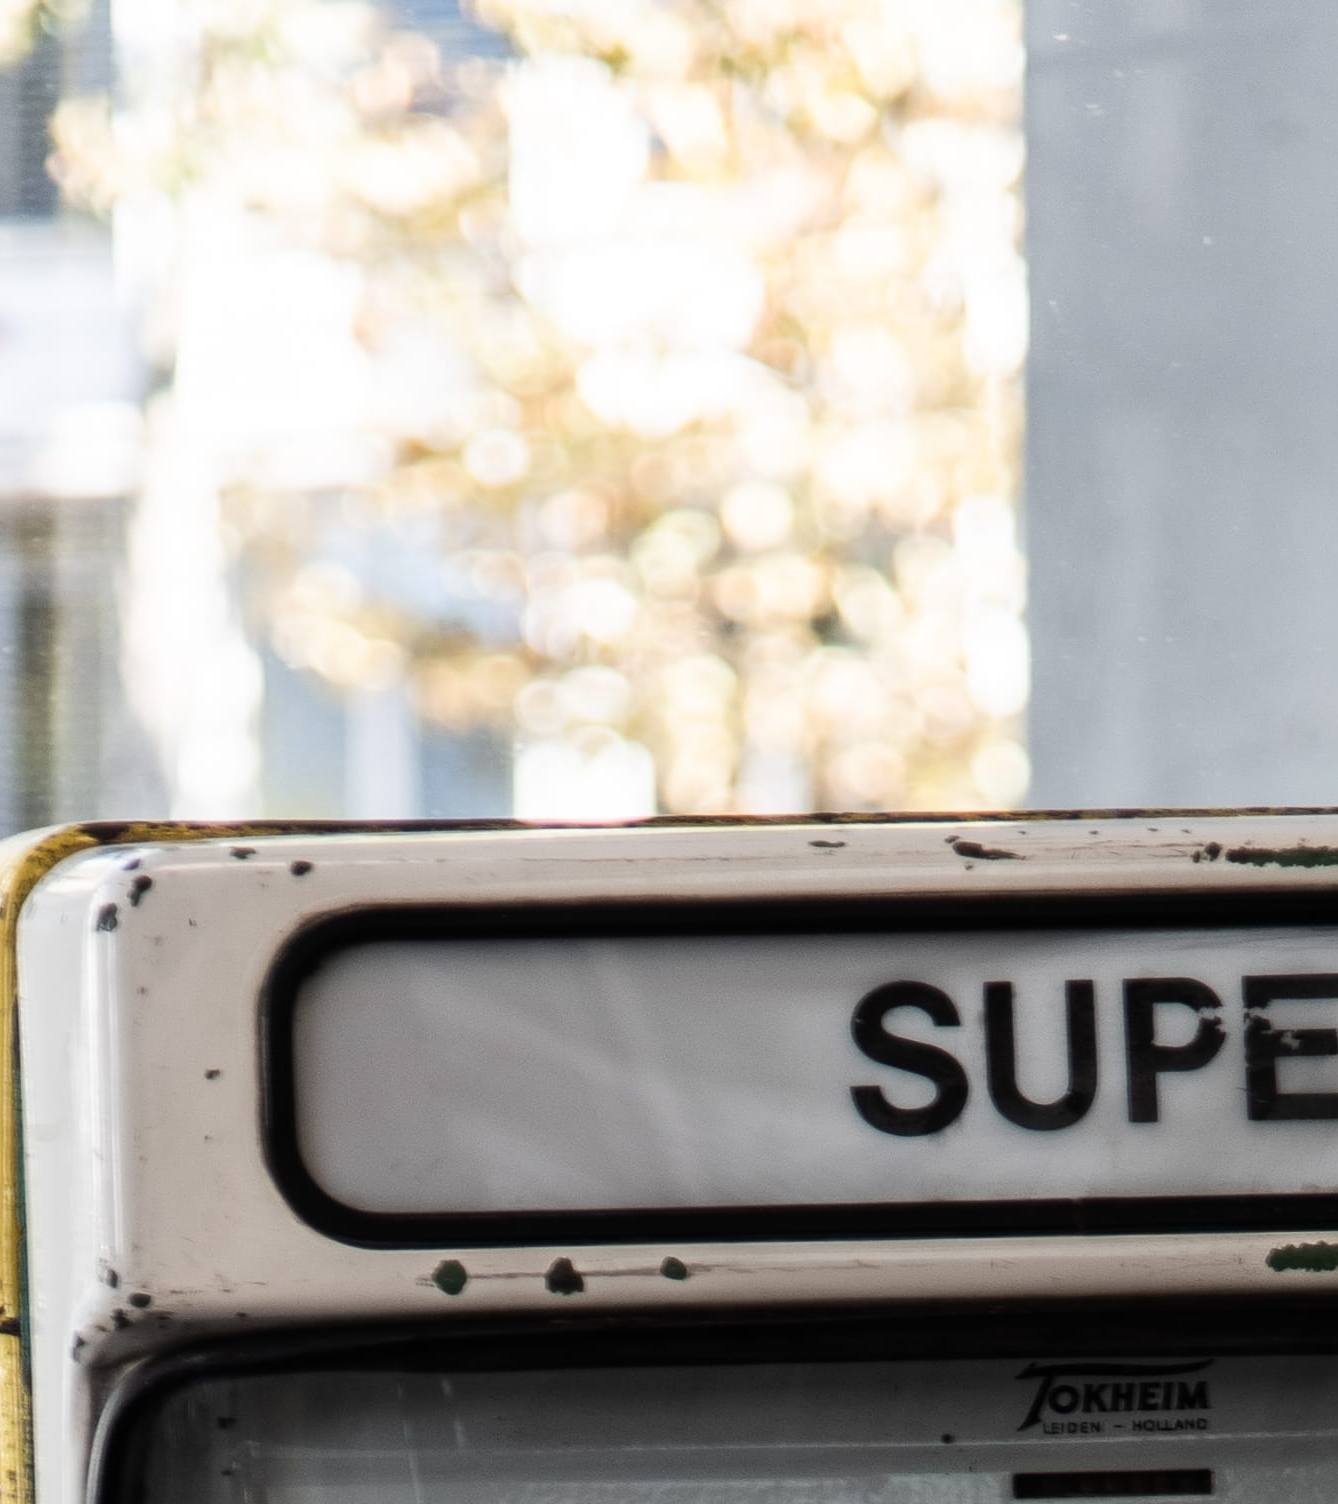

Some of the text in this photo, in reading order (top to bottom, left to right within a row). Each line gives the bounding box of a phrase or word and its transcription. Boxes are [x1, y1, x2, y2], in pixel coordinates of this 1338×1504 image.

[1015, 1359, 1214, 1433] TOKHEIM
[1042, 1420, 1102, 1435] LEIDEN
[1132, 1417, 1209, 1433] HOLLAND
